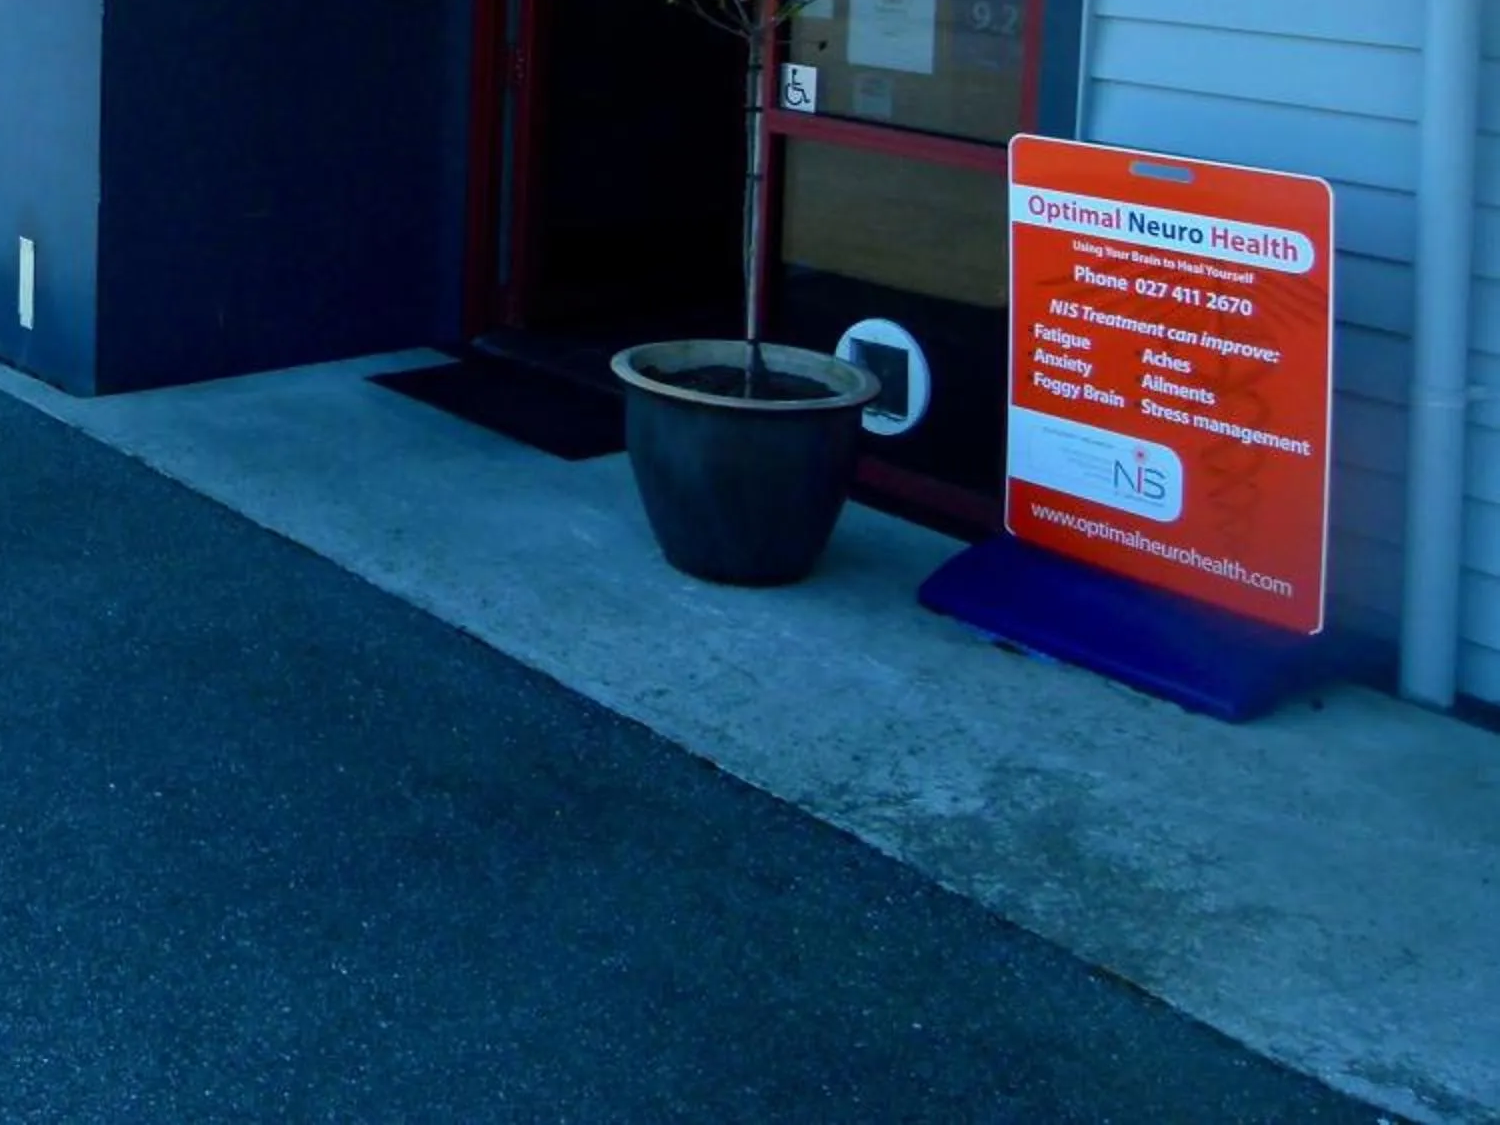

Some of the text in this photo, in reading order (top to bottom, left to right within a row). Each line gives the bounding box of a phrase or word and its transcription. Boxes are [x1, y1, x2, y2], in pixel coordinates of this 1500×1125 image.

[1028, 194, 1298, 262] Optimal Neuro Health
[1073, 240, 1254, 284] Using Your Brain to Heal Yourself
[1074, 265, 1253, 316] Phone 027 411 2670
[1034, 323, 1092, 350] Fatigue
[1049, 299, 1281, 363] NIS Treatment can improve:
[1034, 348, 1092, 377] Anxiety
[1142, 348, 1192, 373] Aches
[1033, 372, 1125, 408] Foggy Brain
[1141, 374, 1216, 405] Ailments
[1141, 398, 1312, 456] Stress management
[1032, 502, 1293, 598] www.optimalneurohealth.com
